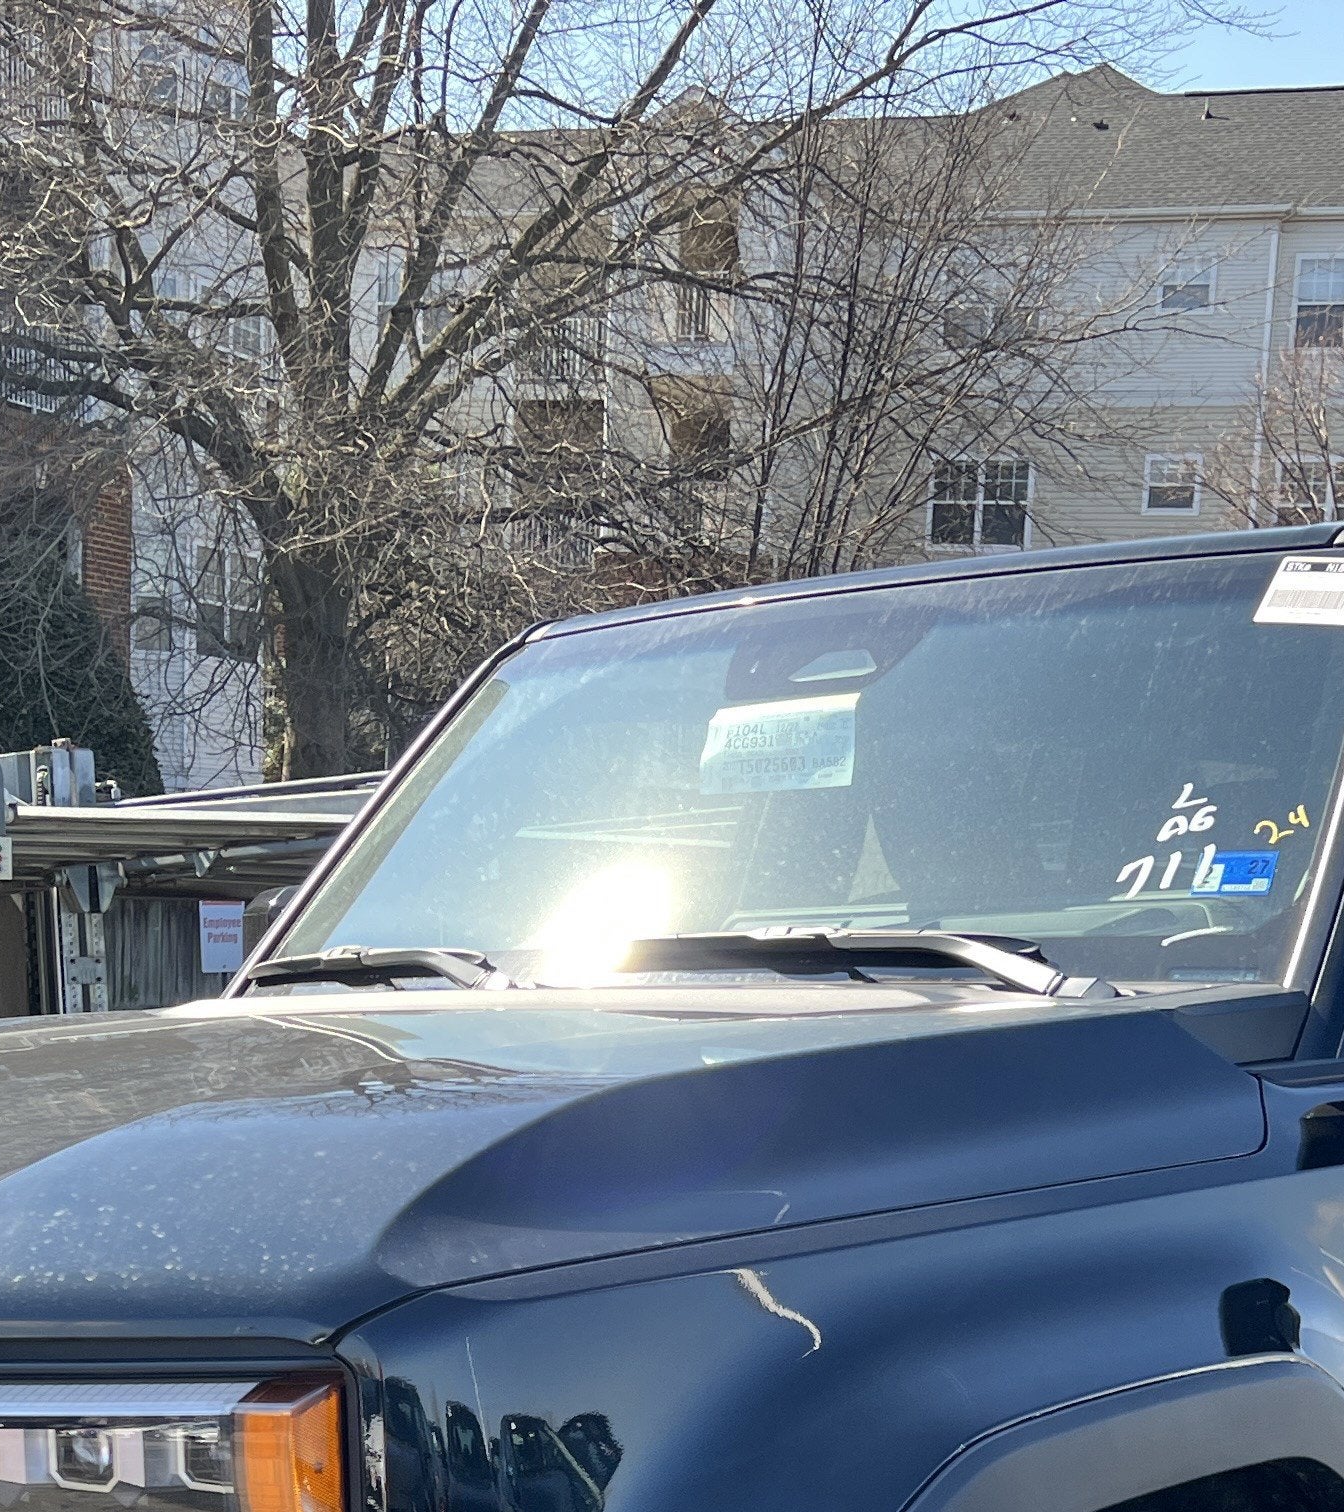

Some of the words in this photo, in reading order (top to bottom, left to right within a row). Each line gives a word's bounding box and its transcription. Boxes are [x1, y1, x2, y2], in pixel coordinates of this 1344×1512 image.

[1248, 859, 1270, 875] 27
[203, 917, 242, 929] Employee
[207, 932, 238, 944] Parking
